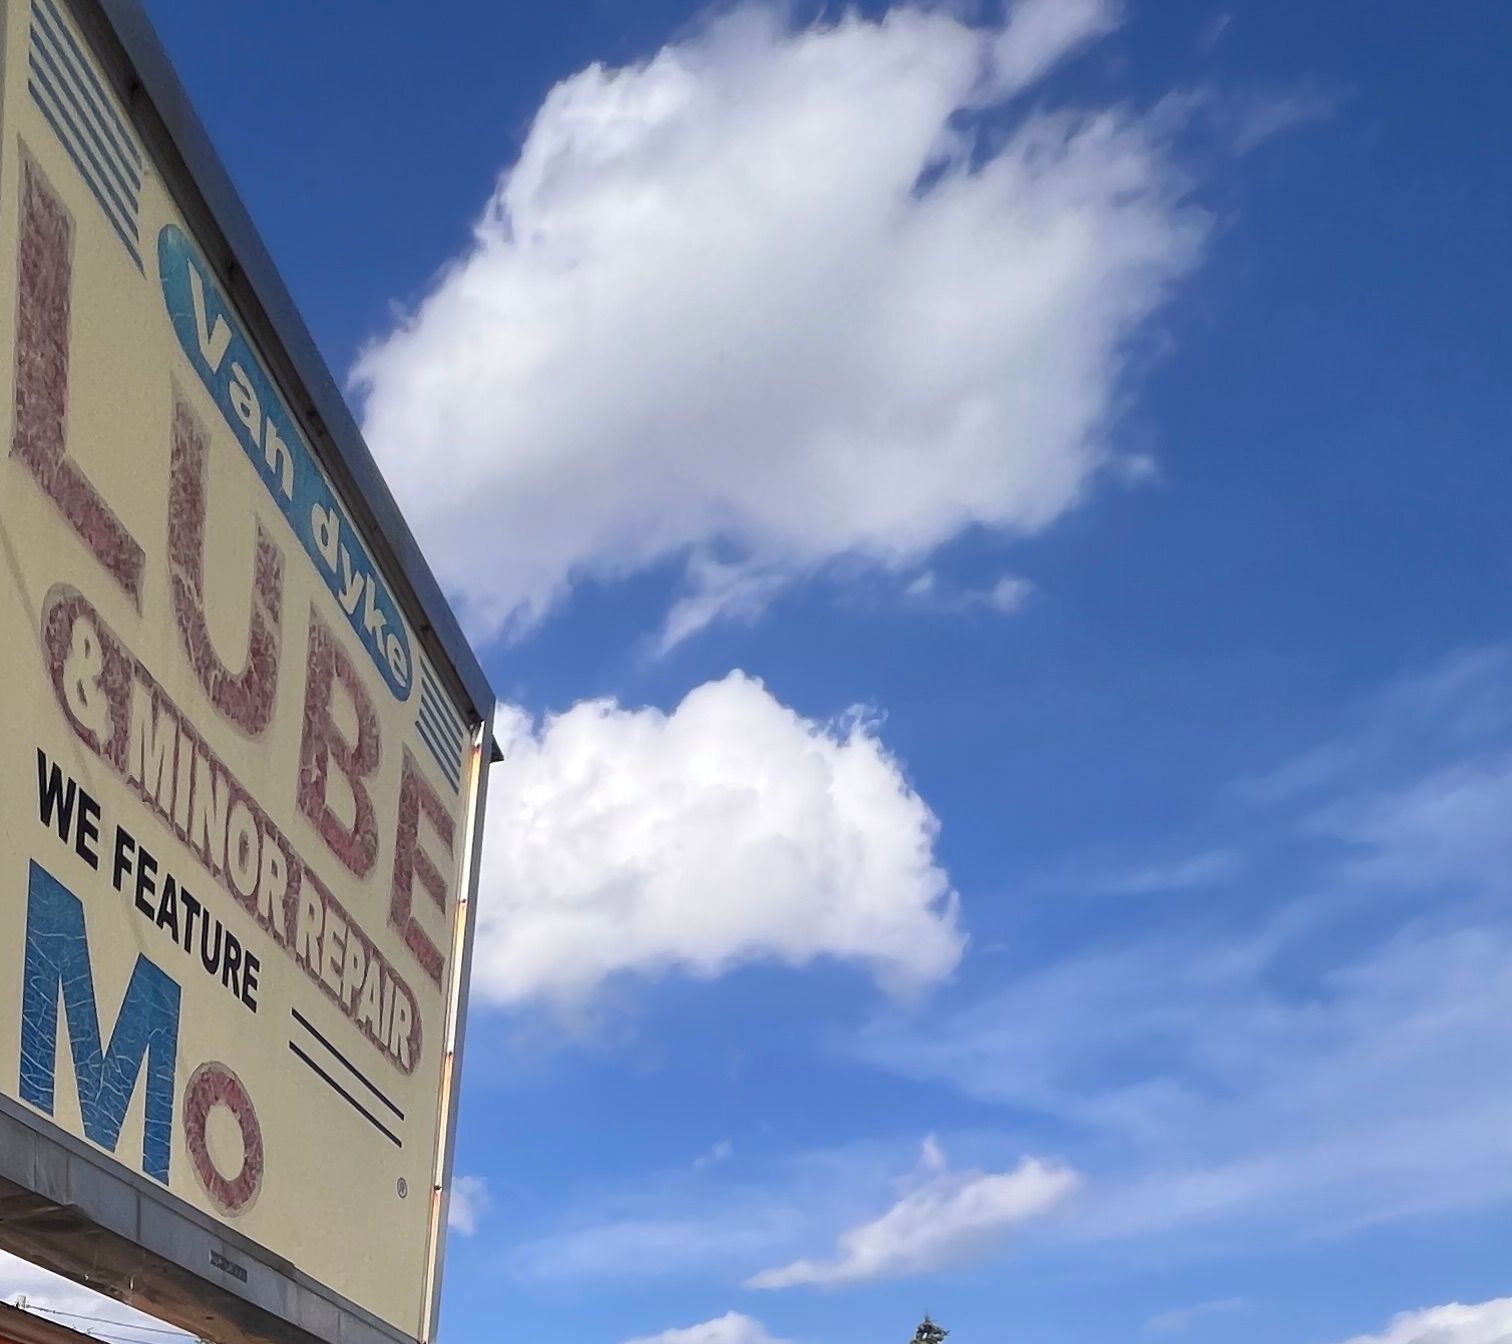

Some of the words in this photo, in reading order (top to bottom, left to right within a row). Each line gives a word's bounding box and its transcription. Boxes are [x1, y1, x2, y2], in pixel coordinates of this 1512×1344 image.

[9, 132, 457, 993] LUBE
[188, 258, 295, 501] Van
[311, 503, 408, 688] dyke
[36, 746, 101, 871] WE
[112, 824, 261, 1014] FEATURE
[63, 615, 113, 745] &
[128, 675, 289, 946] MINOR
[294, 886, 413, 1069] REPAIR
